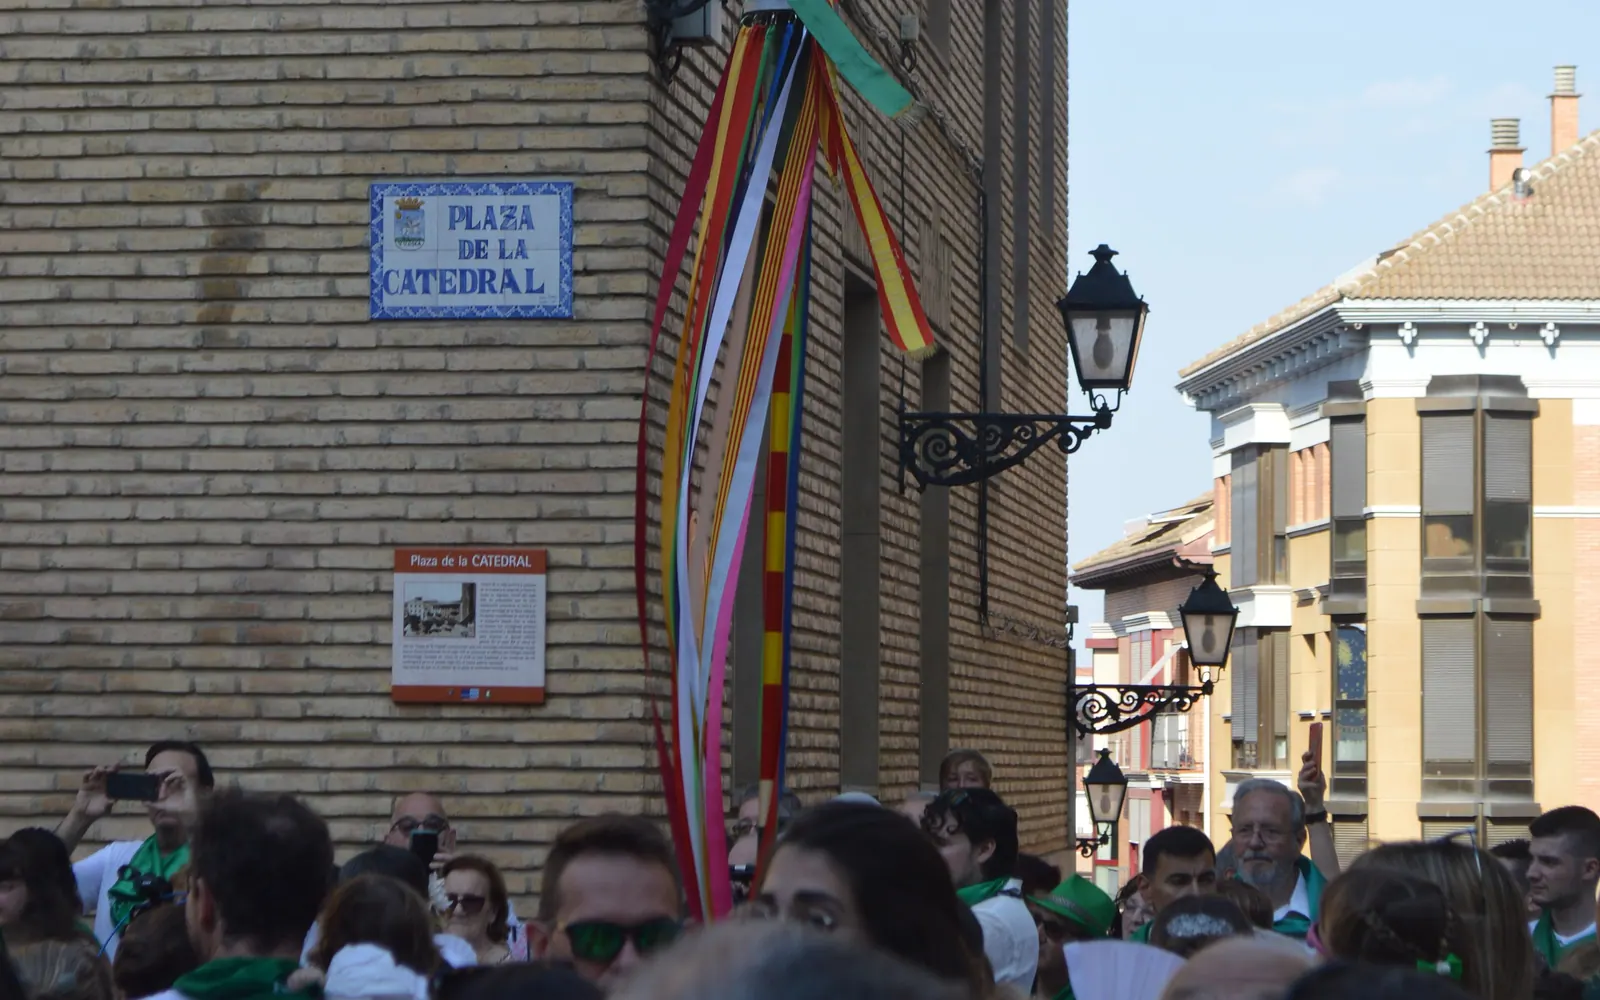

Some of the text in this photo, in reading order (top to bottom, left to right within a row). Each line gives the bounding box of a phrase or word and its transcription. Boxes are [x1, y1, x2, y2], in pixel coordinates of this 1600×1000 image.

[448, 205, 535, 231] PLAZA
[458, 239, 529, 260] DE LA
[383, 268, 545, 295] CATEDRAL
[410, 554, 532, 568] Plaza de la CATEDRAL
